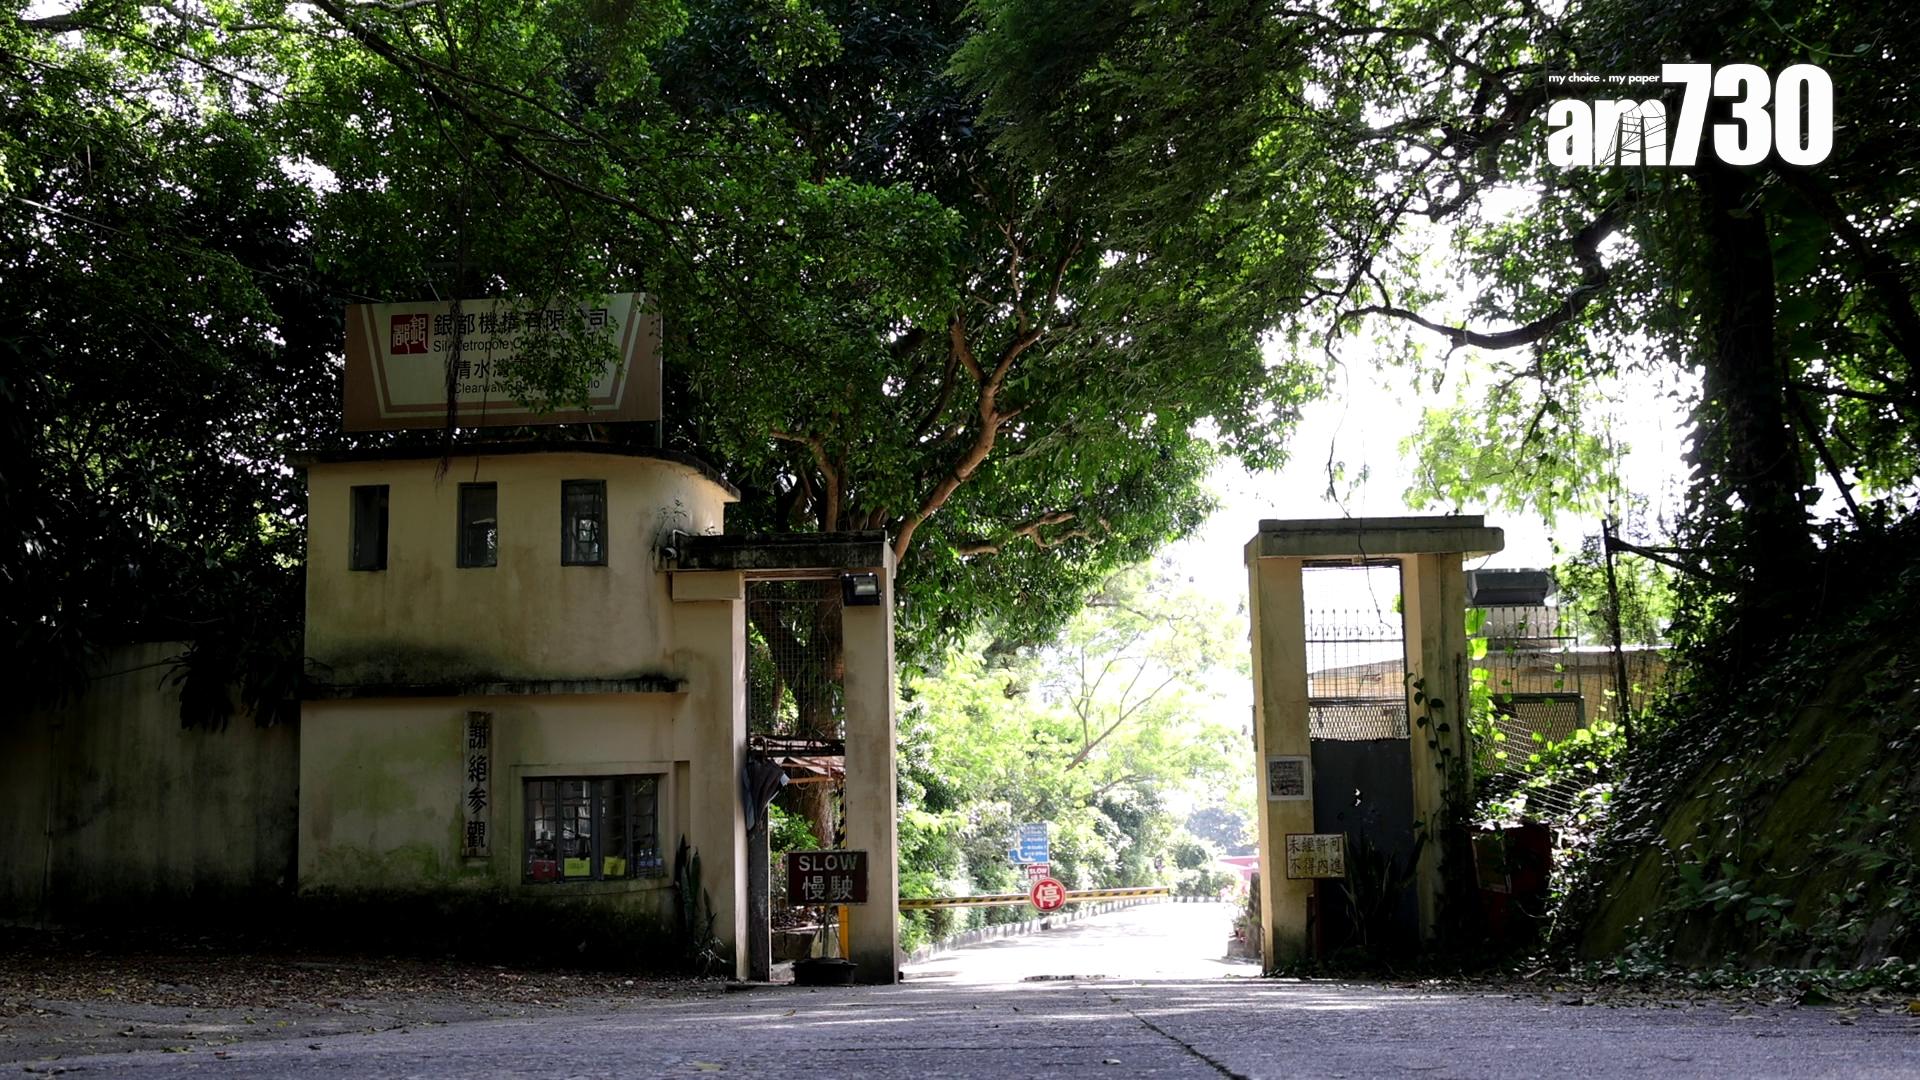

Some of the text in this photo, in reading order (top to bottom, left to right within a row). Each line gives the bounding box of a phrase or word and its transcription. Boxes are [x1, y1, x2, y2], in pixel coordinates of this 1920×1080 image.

[433, 309, 608, 336] 銀都機構有限司
[799, 855, 857, 871] SLOW
[1029, 867, 1047, 876] SLOW
[802, 875, 853, 900] 慢駛
[1036, 884, 1061, 907] 停
